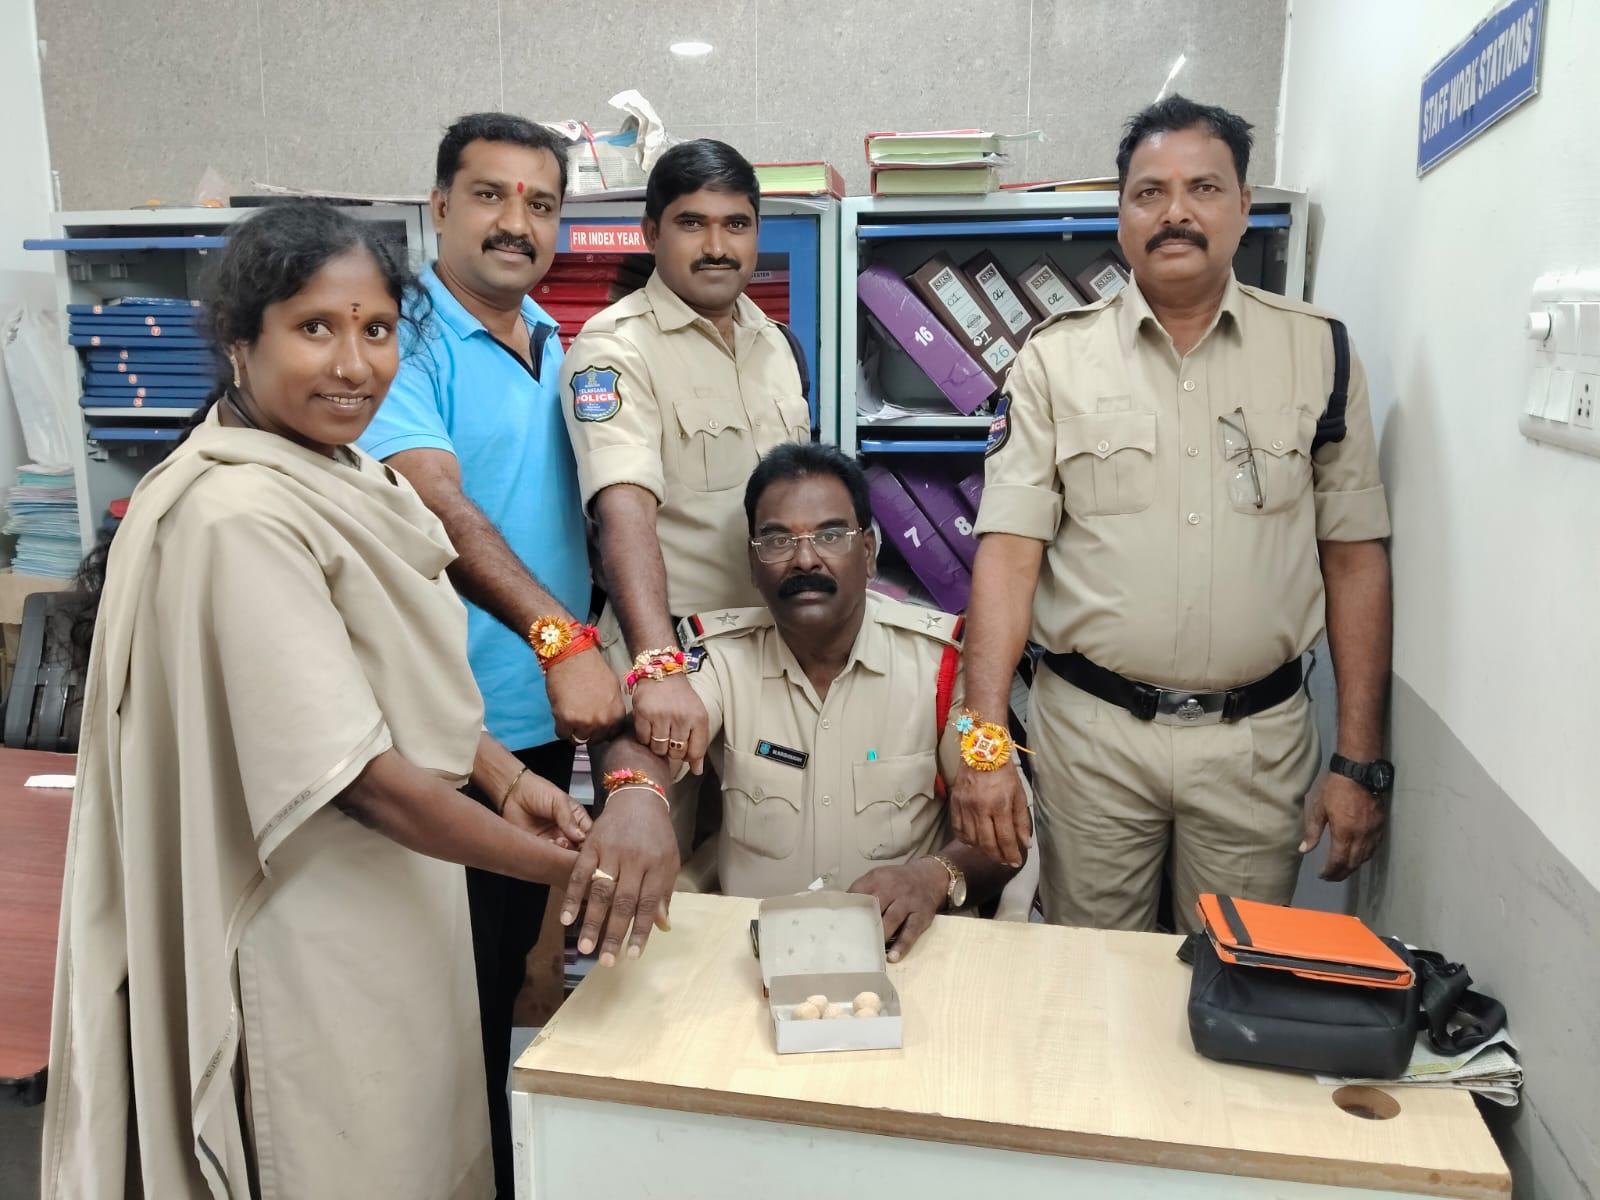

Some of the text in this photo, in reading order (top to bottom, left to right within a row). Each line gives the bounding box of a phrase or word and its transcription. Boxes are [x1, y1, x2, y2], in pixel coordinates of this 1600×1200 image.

[1422, 8, 1534, 143] STAFF WORK STATIONS
[572, 231, 587, 246] FIR
[588, 231, 615, 246] INDEX
[617, 231, 640, 246] YEAR
[914, 326, 934, 347] 16
[989, 344, 1010, 366] 26
[576, 393, 616, 404] POLICE
[954, 516, 973, 536] 8
[904, 526, 921, 548] 7
